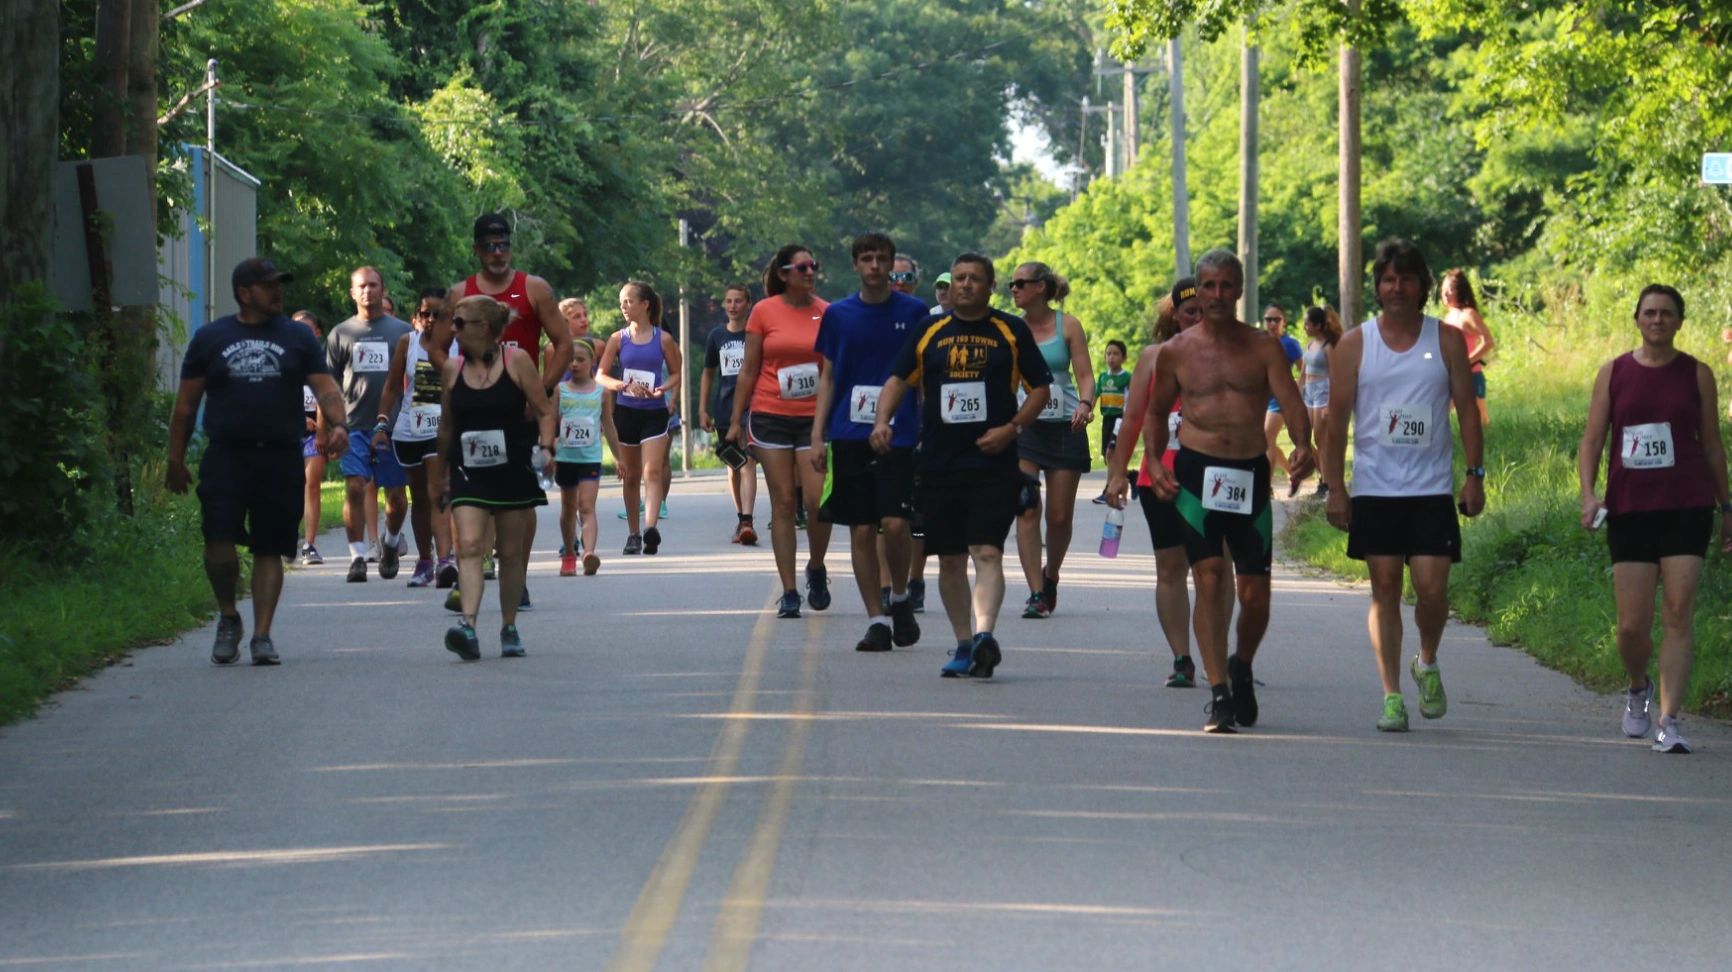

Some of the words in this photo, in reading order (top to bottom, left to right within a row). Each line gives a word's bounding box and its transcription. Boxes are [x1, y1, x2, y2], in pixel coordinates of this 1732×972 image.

[937, 336, 955, 349] RUN
[970, 336, 998, 348] TOWNS
[368, 353, 383, 364] 223
[950, 370, 980, 379] SOCIETY
[798, 376, 815, 390] 316
[960, 397, 980, 412] 265
[575, 428, 590, 440] 224
[1403, 420, 1425, 436] 290
[481, 444, 500, 458] 218
[1645, 440, 1667, 457] 158
[1226, 485, 1246, 503] 384
